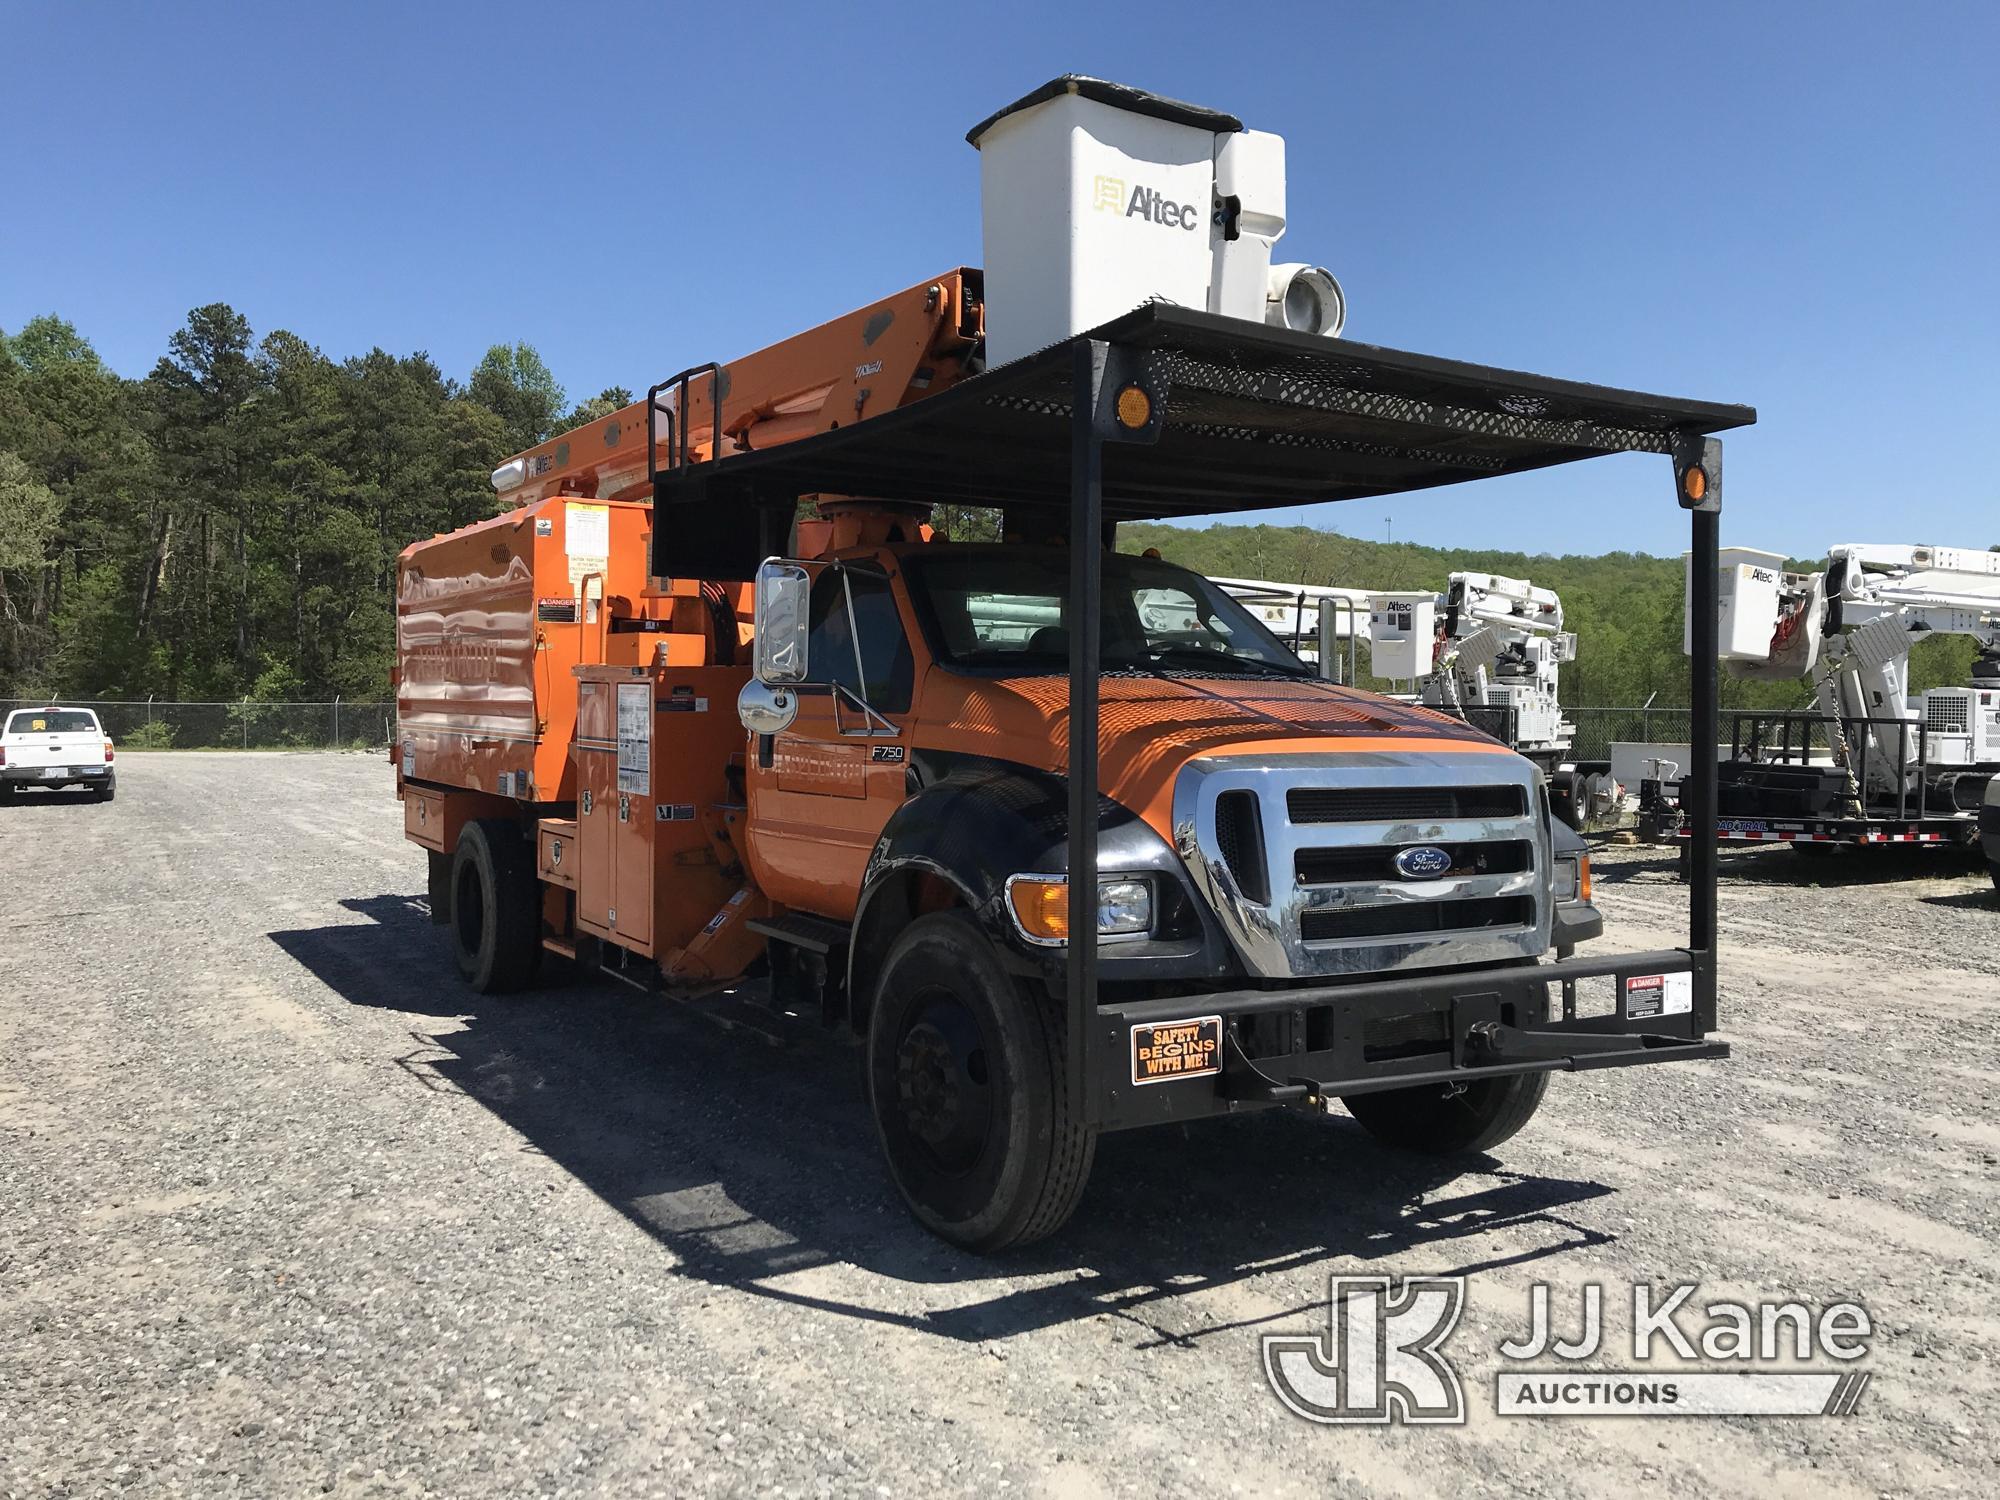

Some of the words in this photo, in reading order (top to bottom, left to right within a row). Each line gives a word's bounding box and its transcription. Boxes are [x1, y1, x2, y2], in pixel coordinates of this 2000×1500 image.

[1126, 185, 1197, 231] Altec
[535, 453, 553, 474] Altec
[1752, 568, 1773, 583] Altec
[1387, 601, 1412, 611] Altec
[1741, 821, 1768, 831] TRAIL
[1412, 850, 1442, 871] Ford
[1637, 977, 1660, 987] DANGER
[1153, 1026, 1199, 1045] SAFETY
[1139, 1039, 1215, 1060] BEGINS
[1146, 1056, 1182, 1074] WITH
[1184, 1052, 1209, 1070] ME!
